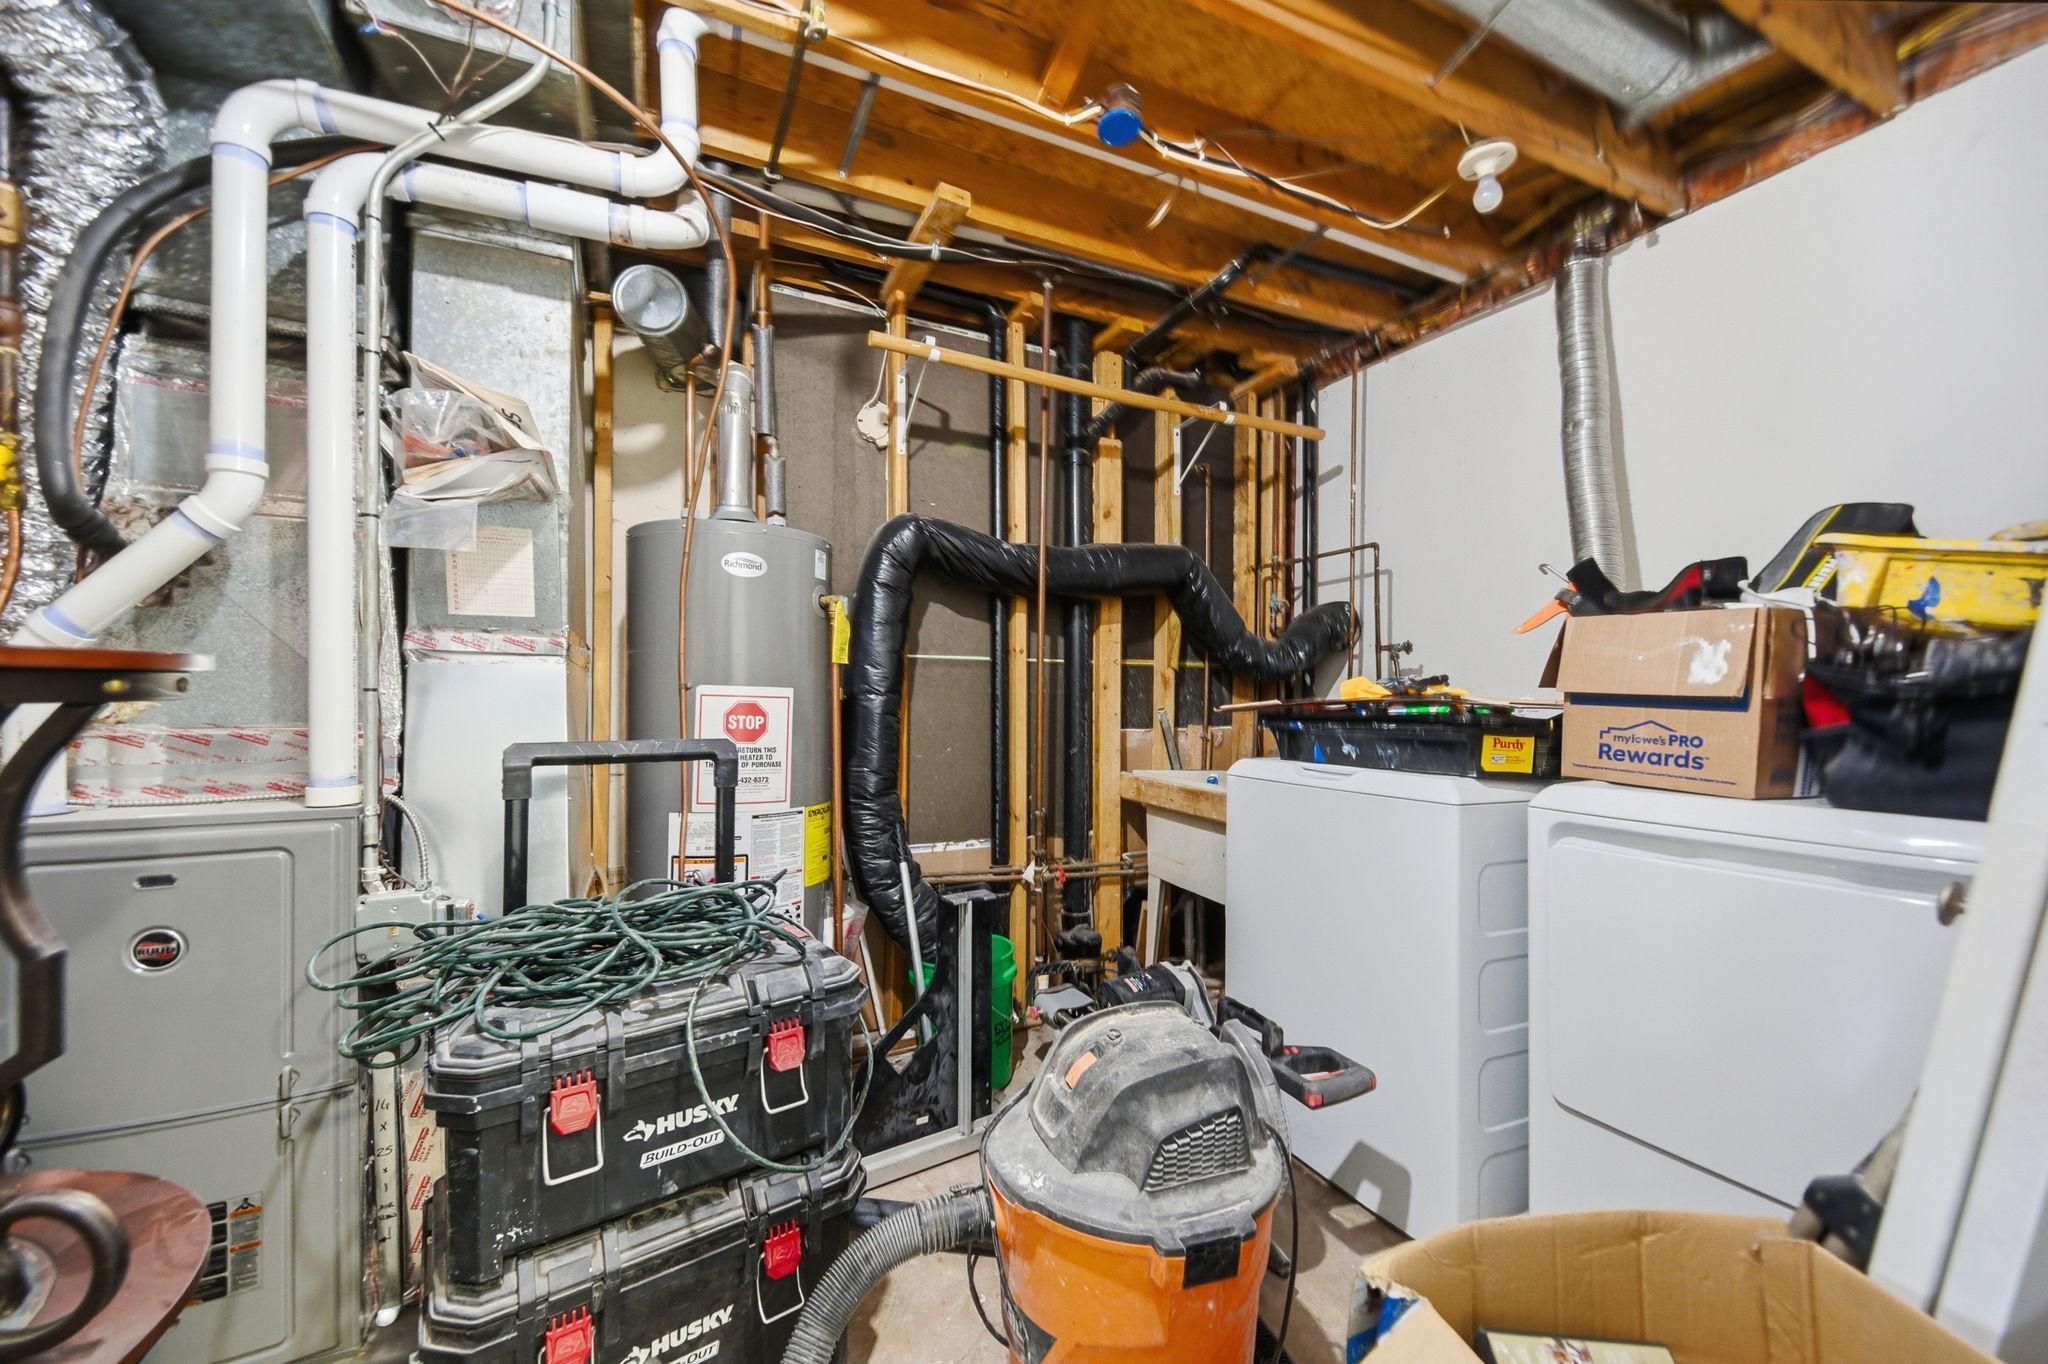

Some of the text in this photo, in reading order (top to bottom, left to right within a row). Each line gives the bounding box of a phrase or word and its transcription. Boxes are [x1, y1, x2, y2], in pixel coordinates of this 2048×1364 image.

[724, 559, 762, 571] Richmond
[728, 714, 765, 730] STOP
[1493, 737, 1524, 751] Purdy
[1668, 734, 1704, 748] PRO
[1598, 743, 1704, 770] Rewards
[657, 1094, 740, 1135] HUSKY
[643, 1131, 722, 1165] BUILD-OUT
[651, 1304, 734, 1358] HUSKY
